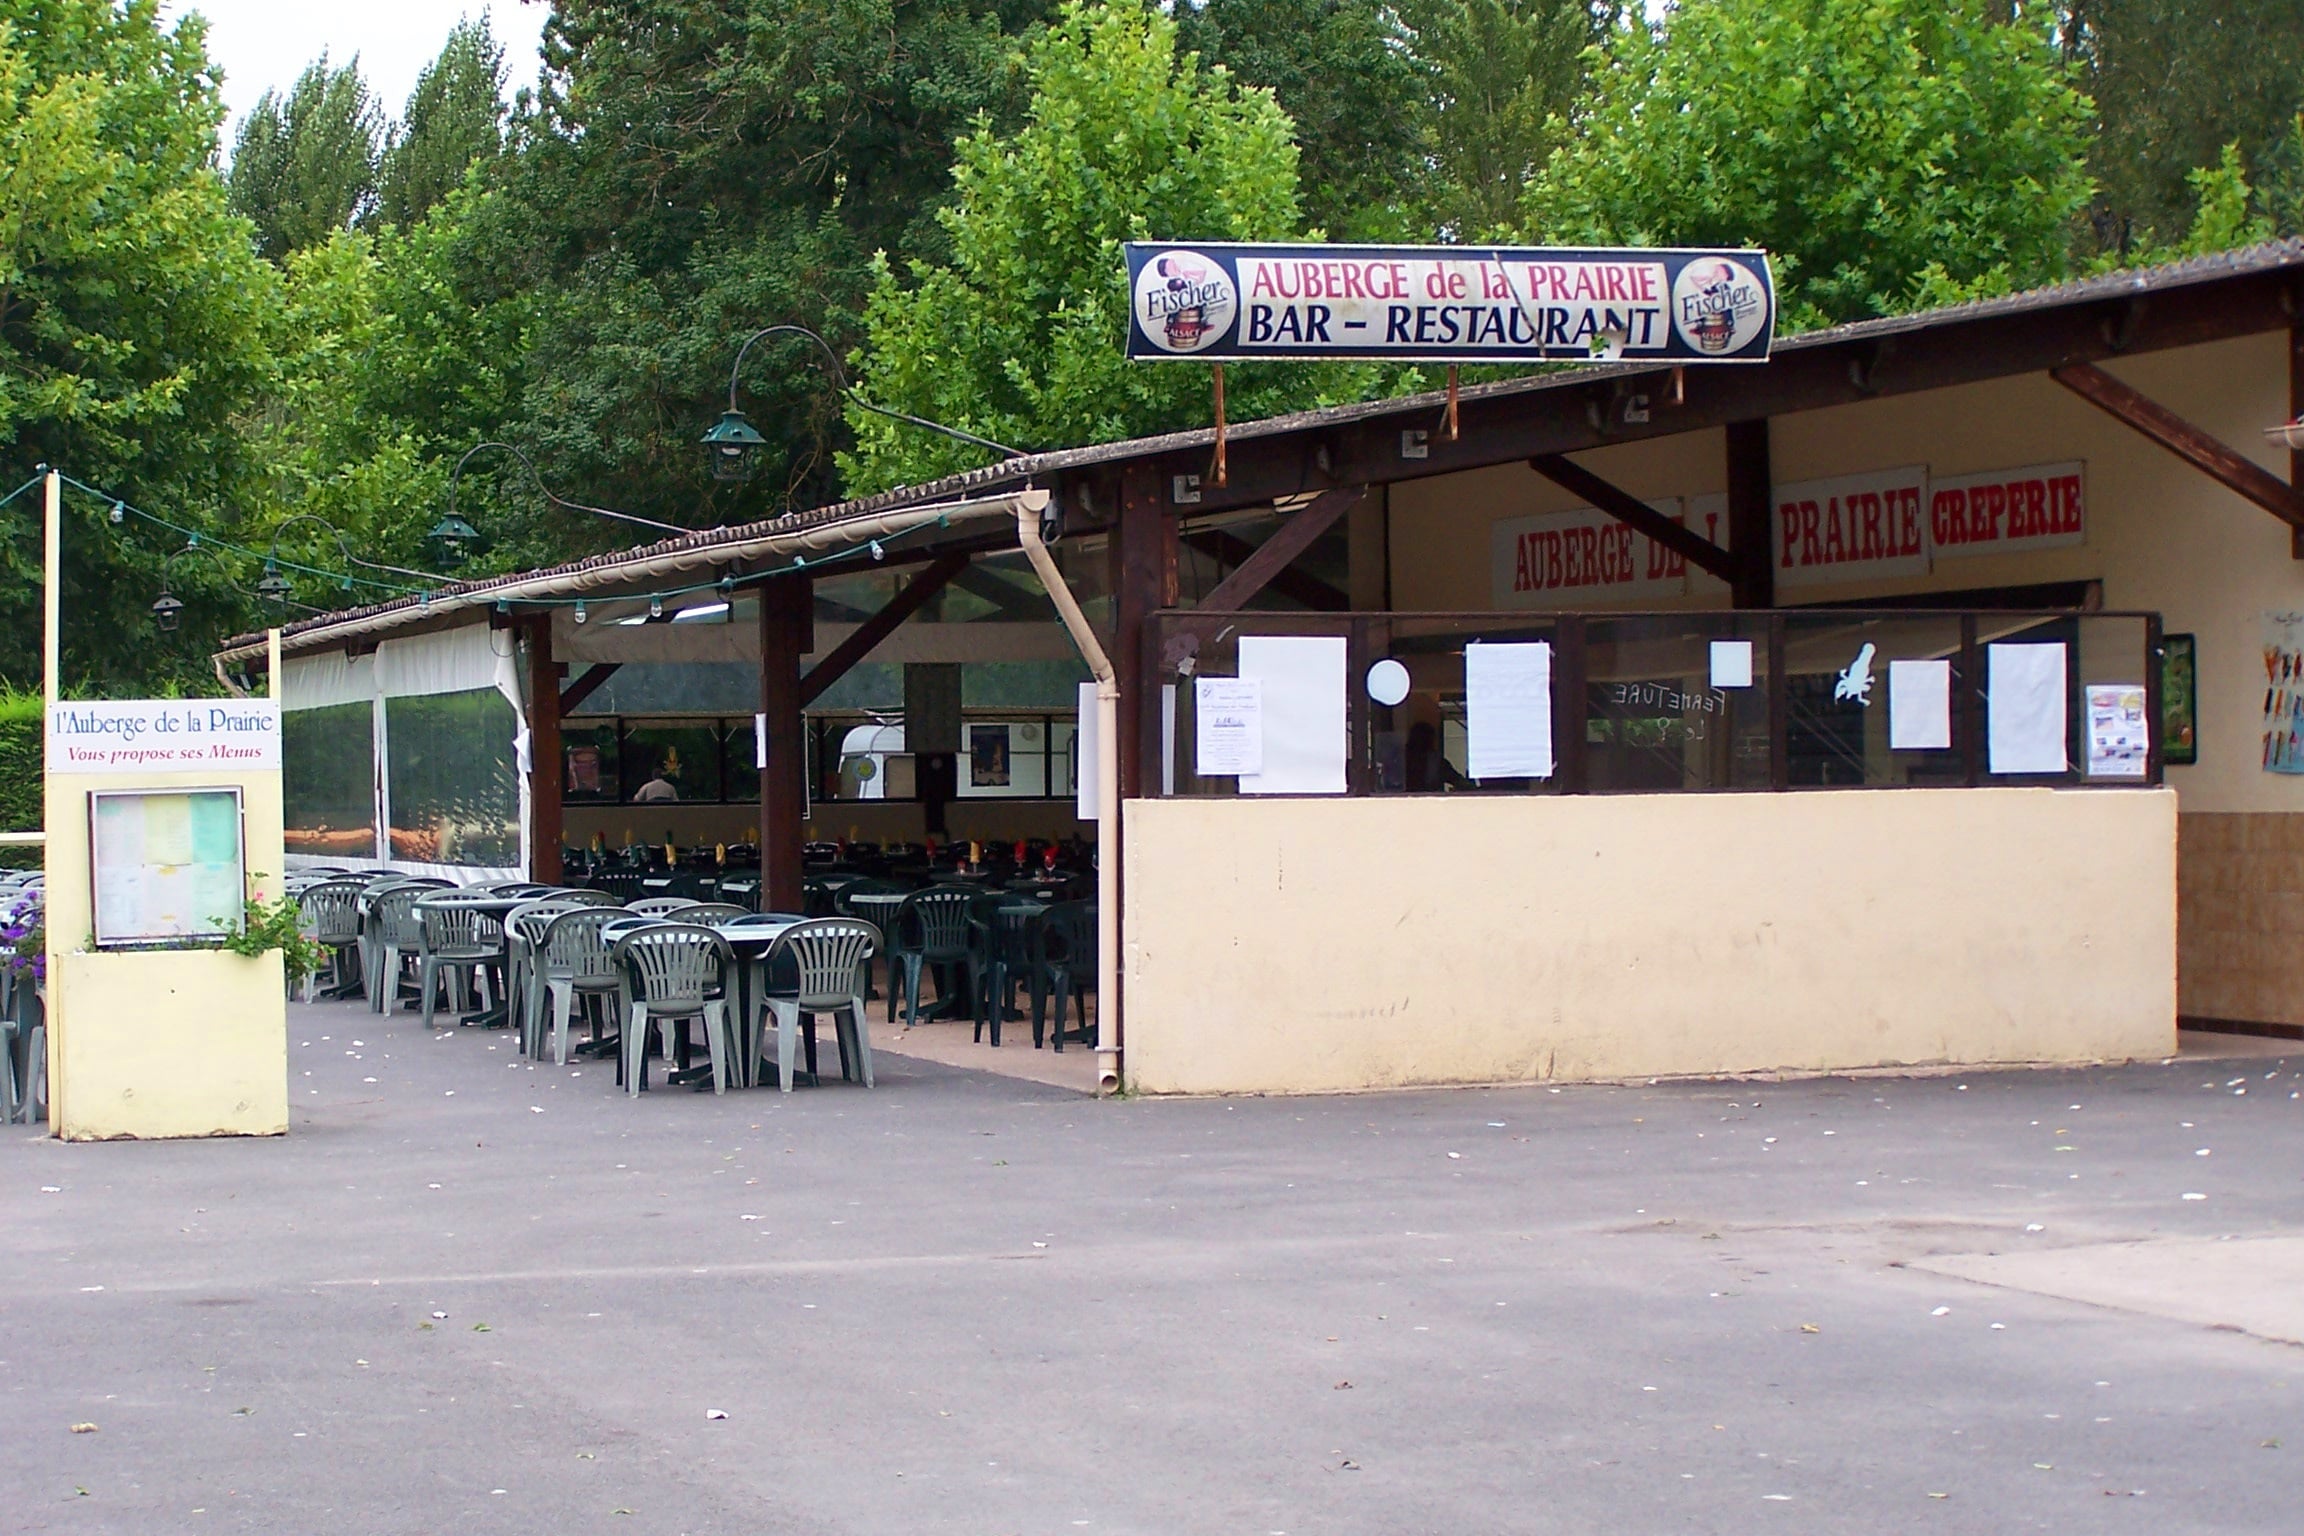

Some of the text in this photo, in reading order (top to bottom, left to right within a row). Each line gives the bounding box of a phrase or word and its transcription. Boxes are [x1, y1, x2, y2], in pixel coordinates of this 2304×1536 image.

[1146, 280, 1221, 317] Fischer
[1252, 261, 1657, 301] AUBERGE de la PRAIRIE
[1682, 283, 1750, 321] Fischer
[1249, 304, 1331, 343] BAR
[1386, 305, 1660, 345] RESTAURANT
[1931, 475, 2081, 547] CREPERIE
[1514, 522, 1634, 592] AUBERGE
[1779, 486, 1921, 568] PRAIRIE
[56, 708, 273, 742] l'Auberge de la Prairie
[68, 744, 262, 765] Vous propose ses Menus
